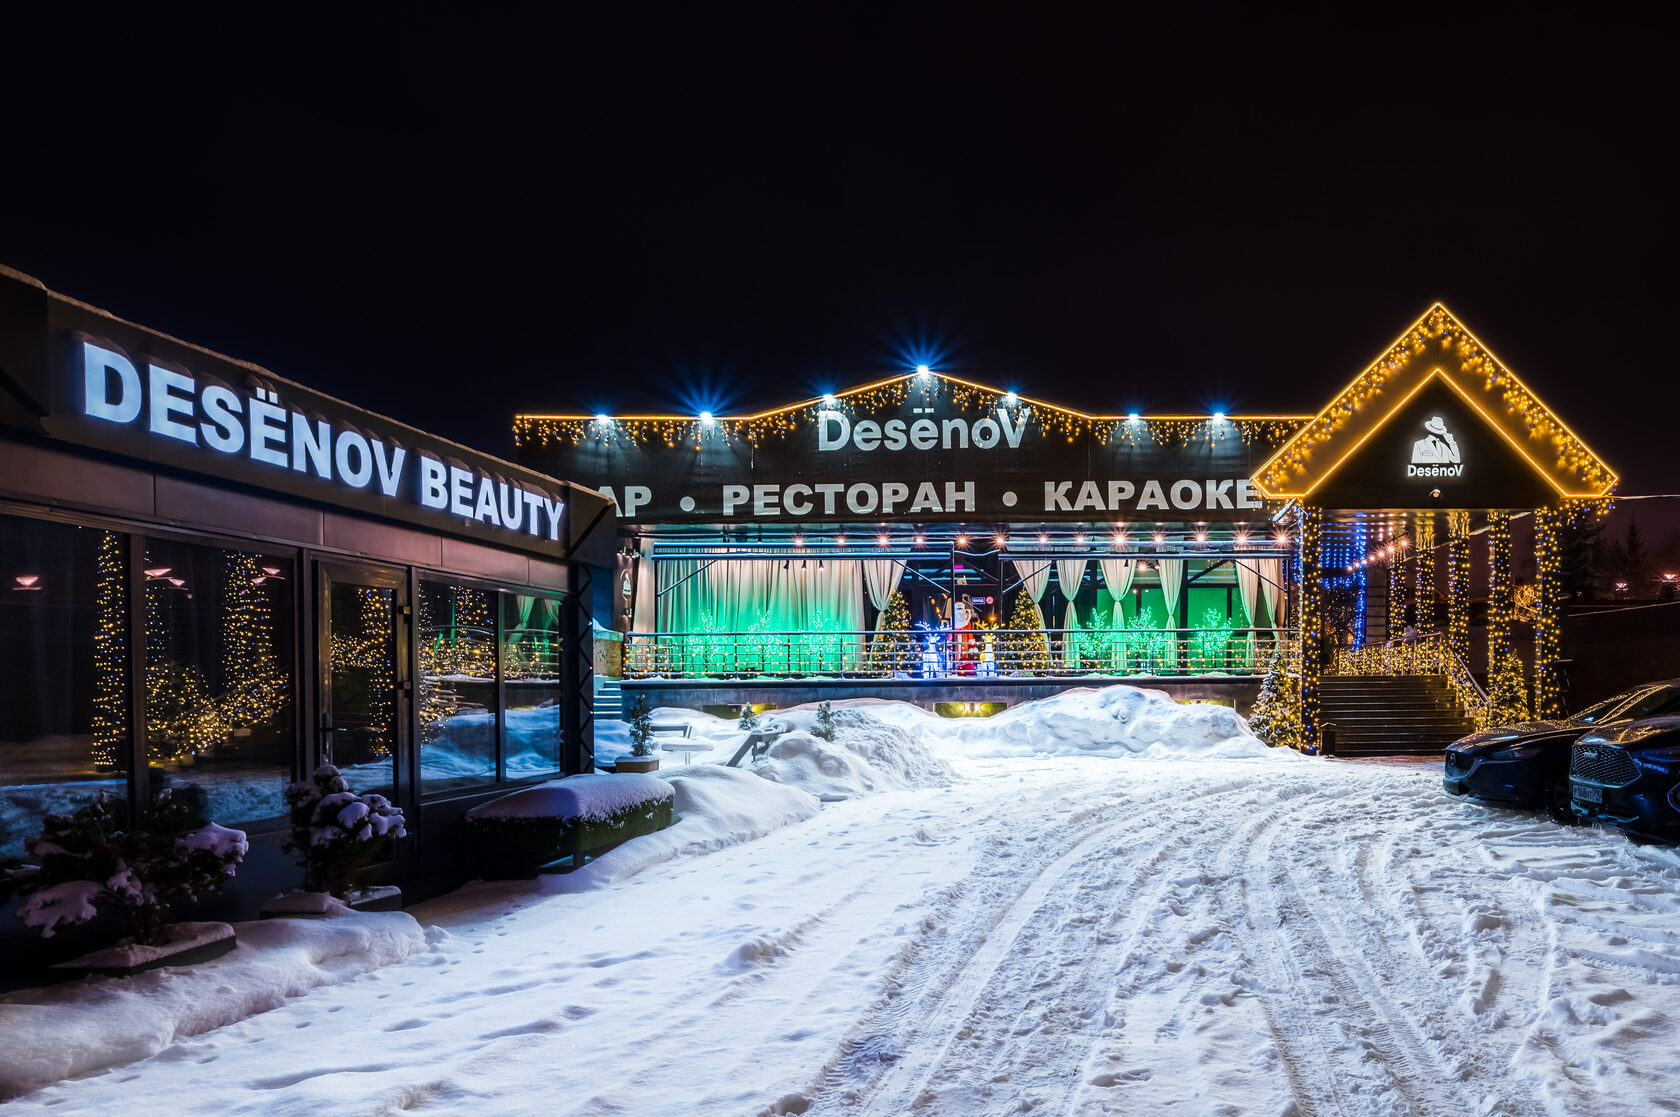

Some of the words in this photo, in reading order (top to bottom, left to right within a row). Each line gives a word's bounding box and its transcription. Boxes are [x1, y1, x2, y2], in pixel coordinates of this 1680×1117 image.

[83, 342, 406, 497] DESËNOV
[421, 456, 565, 541] BEAUTY
[818, 407, 1031, 451] DesënoV
[1407, 464, 1464, 477] DesënoV
[722, 481, 976, 516] РЕСТОРАН
[1044, 479, 1263, 511] КАРАОКЕ
